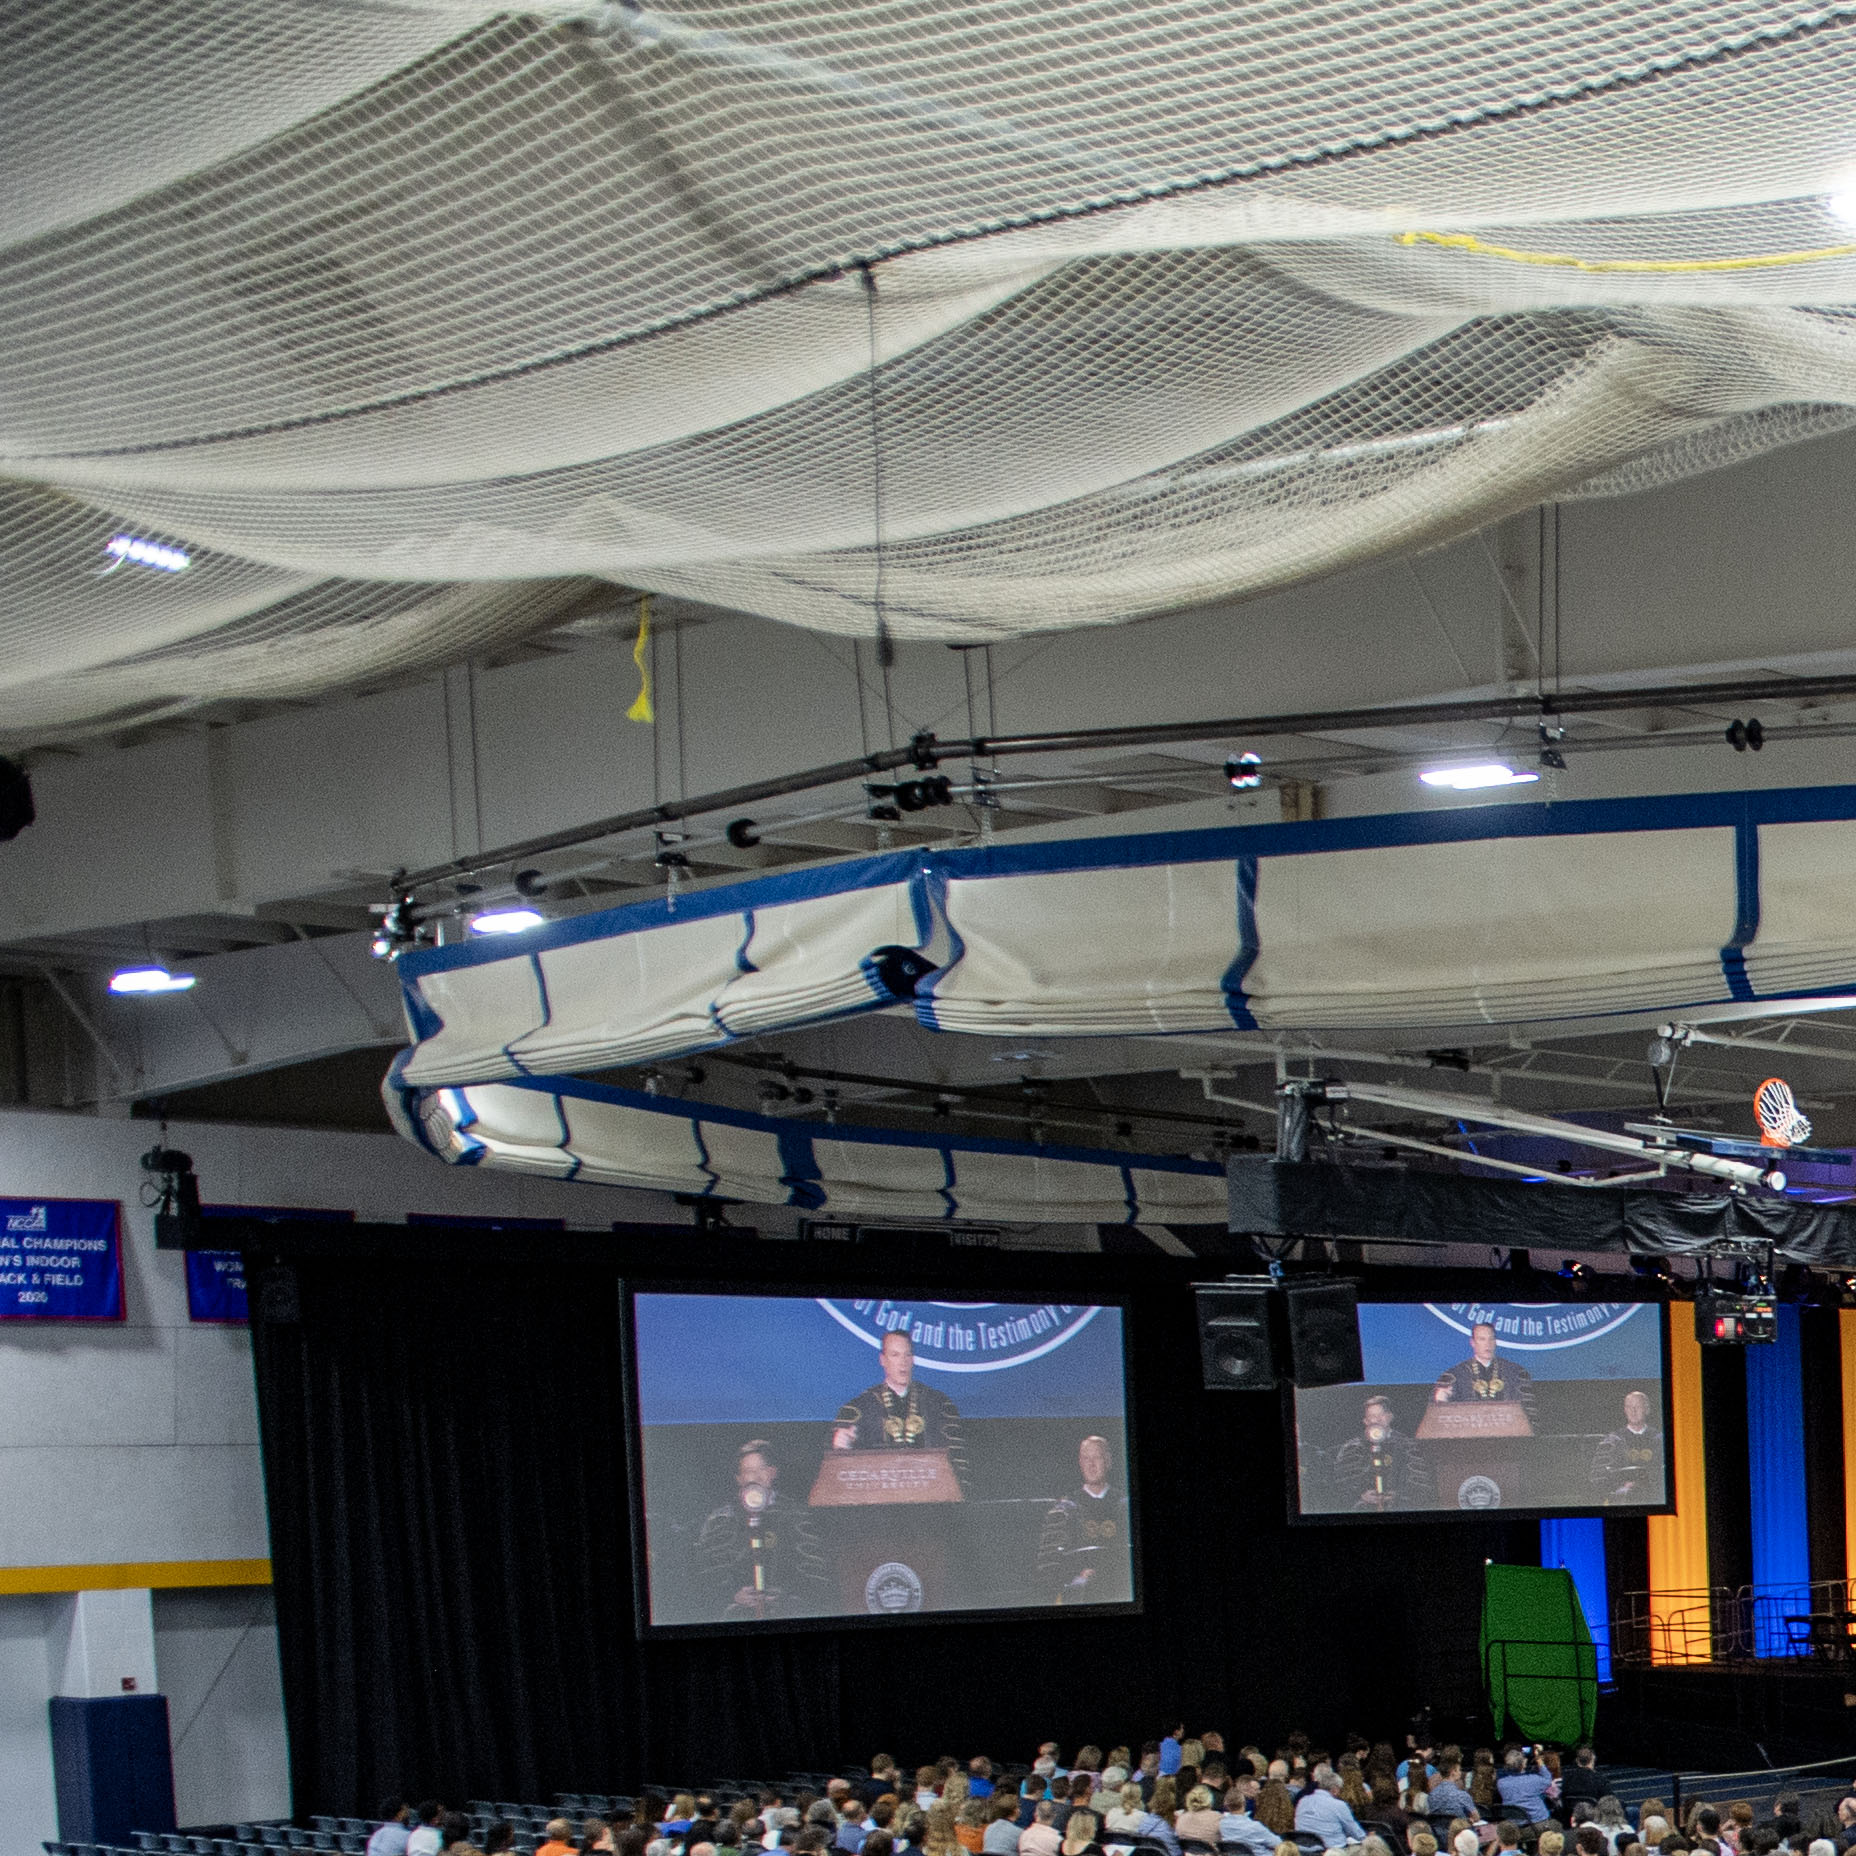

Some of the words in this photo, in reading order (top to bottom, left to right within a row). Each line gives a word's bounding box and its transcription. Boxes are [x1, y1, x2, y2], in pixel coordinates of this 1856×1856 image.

[22, 1237, 107, 1251] CHAMPIONS
[26, 1255, 82, 1268] INDOOR
[0, 1273, 27, 1285] ACK
[31, 1272, 40, 1285] &
[43, 1273, 84, 1286] FIELD
[875, 1300, 912, 1331] God
[911, 1320, 946, 1349] and
[948, 1324, 977, 1351] the
[977, 1305, 1060, 1350] Testimony
[1467, 1303, 1495, 1325] God
[1494, 1315, 1520, 1335] and
[1522, 1317, 1544, 1336] the
[1546, 1303, 1611, 1335] Testimony
